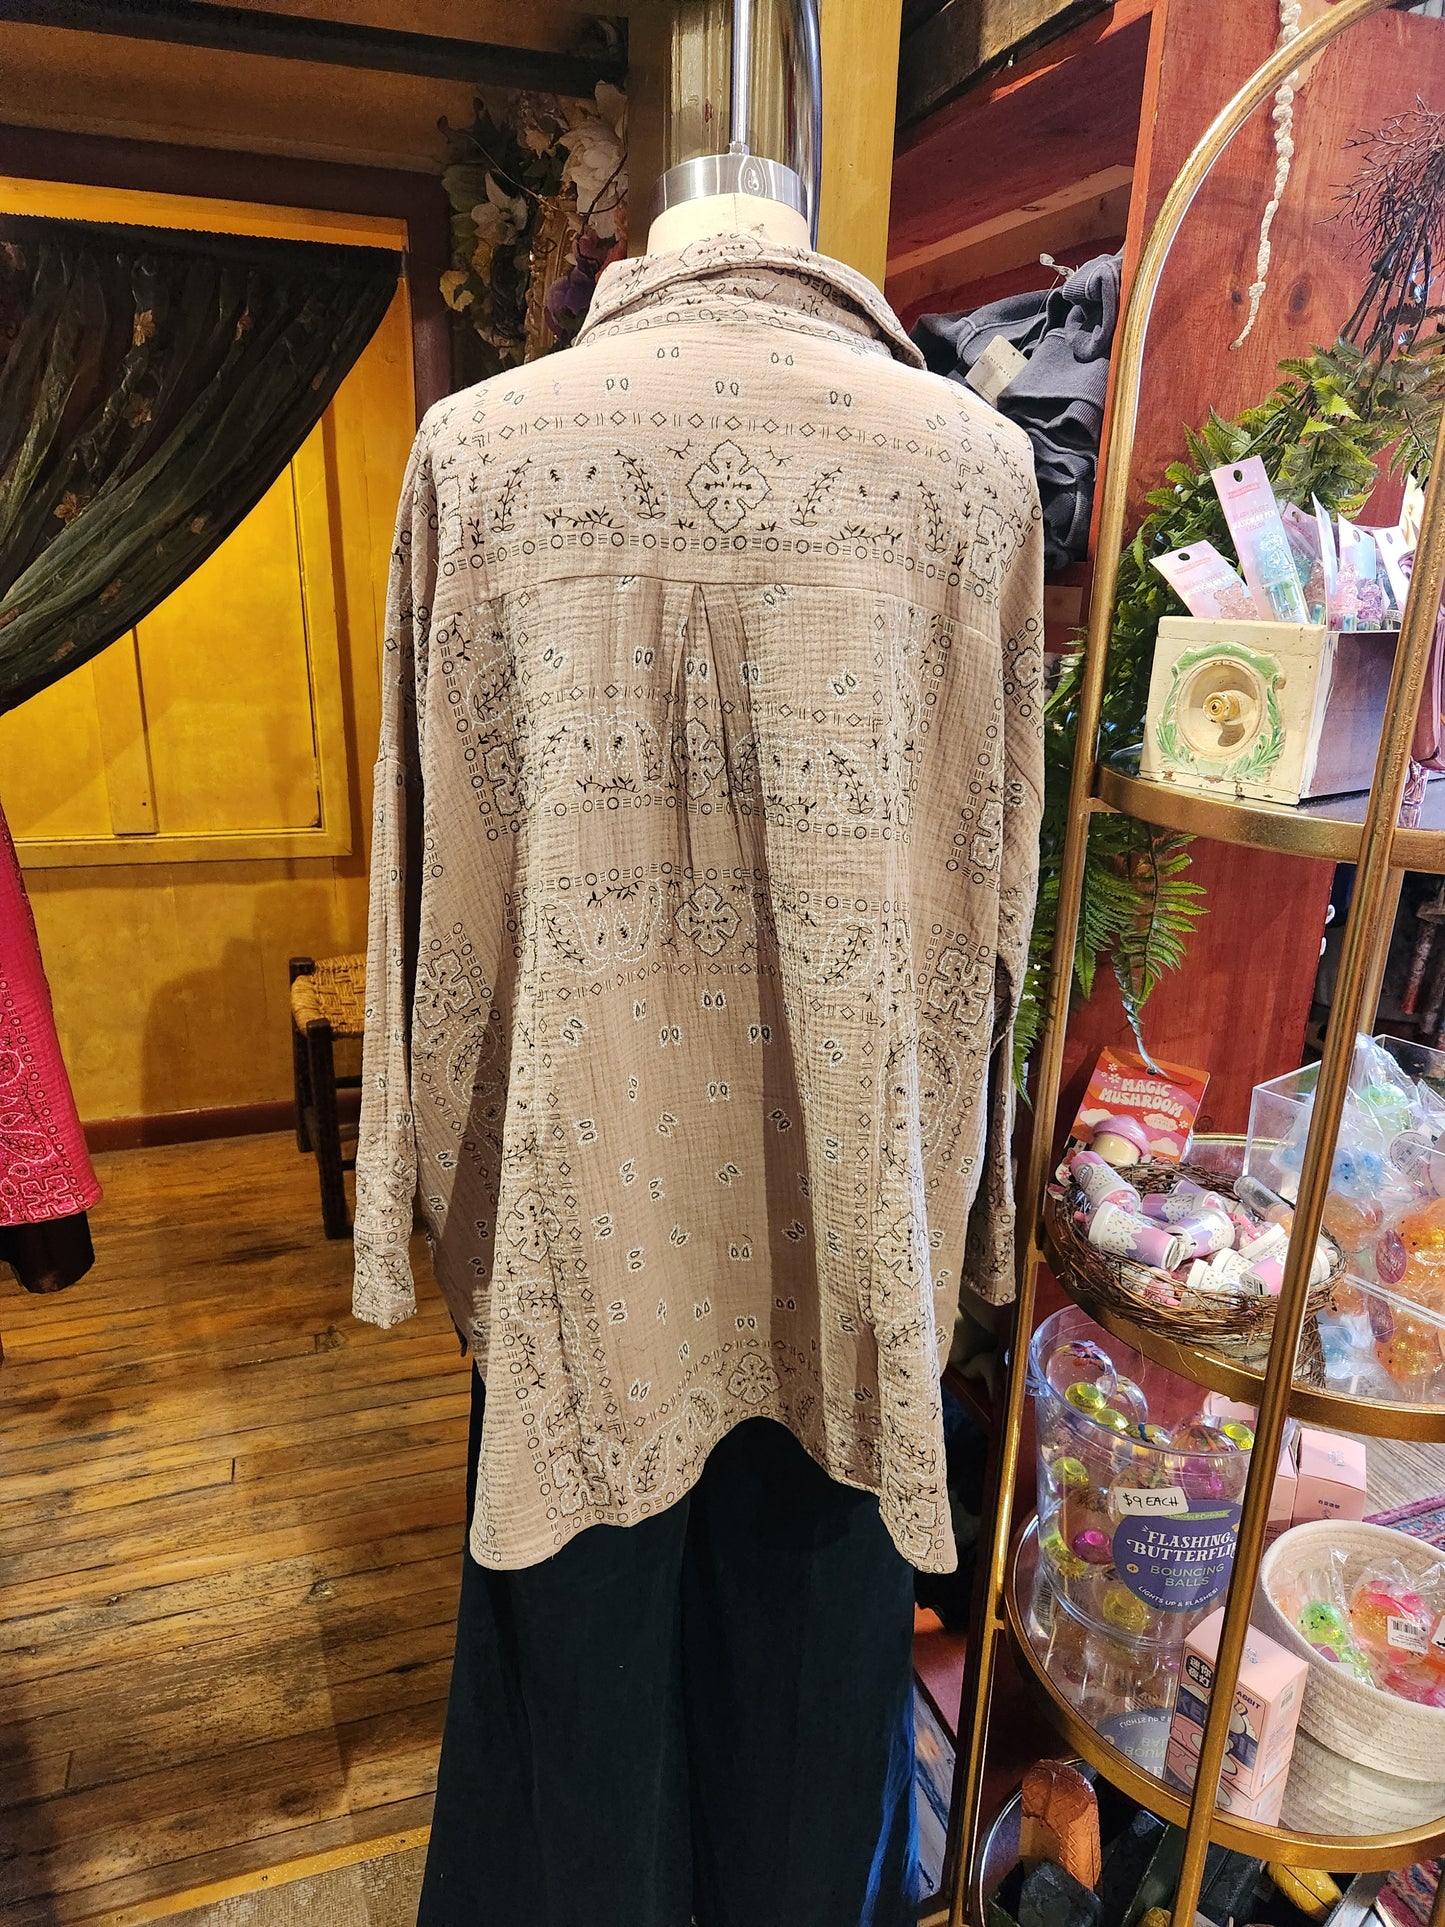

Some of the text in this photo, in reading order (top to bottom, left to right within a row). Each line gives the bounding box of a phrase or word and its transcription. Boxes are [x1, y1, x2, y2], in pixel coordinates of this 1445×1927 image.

[1099, 1088, 1184, 1118] MUSHROOM
[1123, 1493, 1179, 1508] $9 EACH
[1147, 1531, 1234, 1549] FLASHING
[1150, 1563, 1225, 1577] BOUNCING
[1165, 1577, 1209, 1587] BALLS
[1138, 1586, 1163, 1604] LIGHTS
[1185, 1587, 1219, 1606] FLASHES!
[1236, 1690, 1261, 1710] ABBIT
